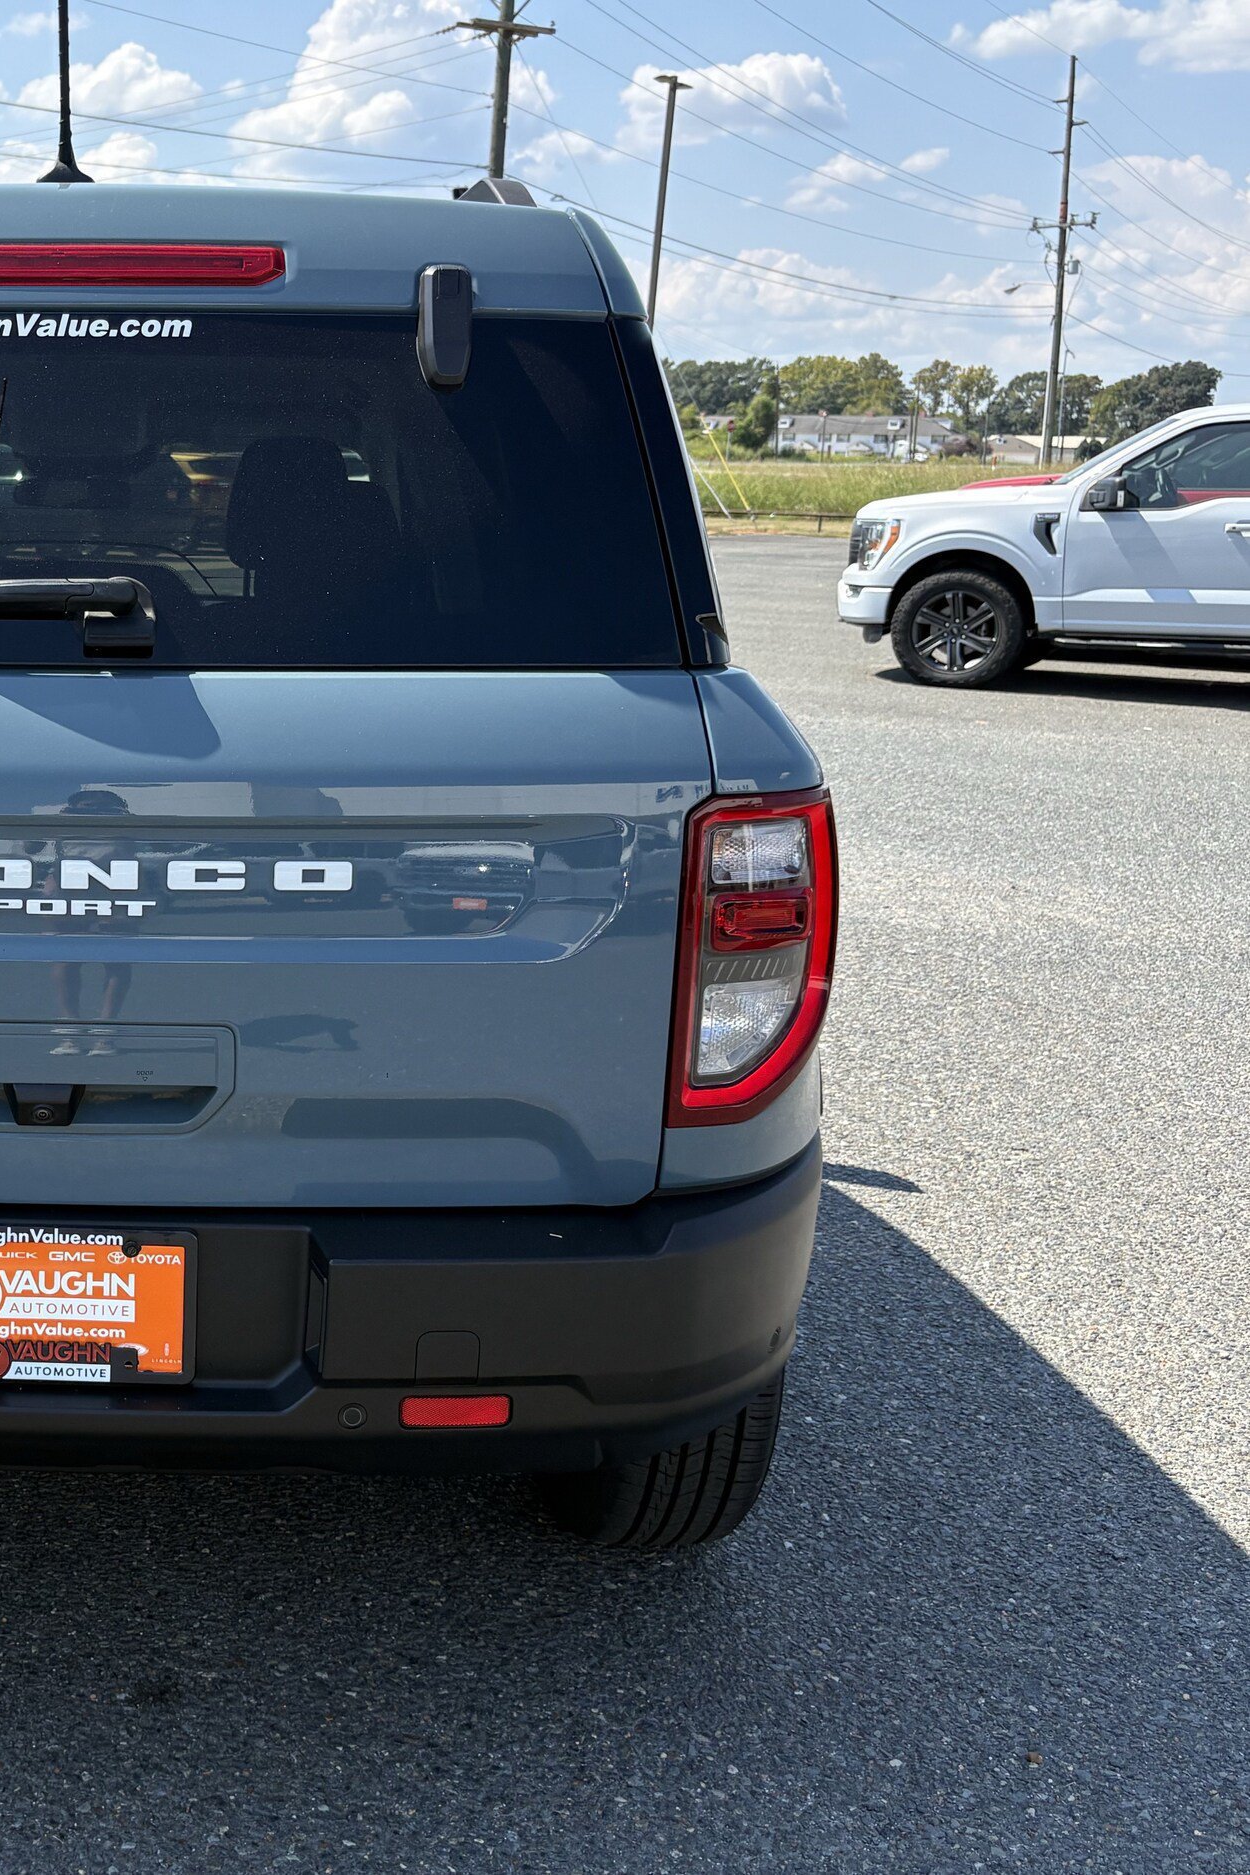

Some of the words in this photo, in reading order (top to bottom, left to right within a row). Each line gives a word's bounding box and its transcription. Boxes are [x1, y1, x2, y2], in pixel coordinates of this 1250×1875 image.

[48, 1251, 96, 1263] GMC
[9, 1302, 130, 1317] AUTOMOTIVE
[5, 1338, 111, 1363] VAUGHN
[14, 1365, 107, 1378] AUTOMOTIVE
